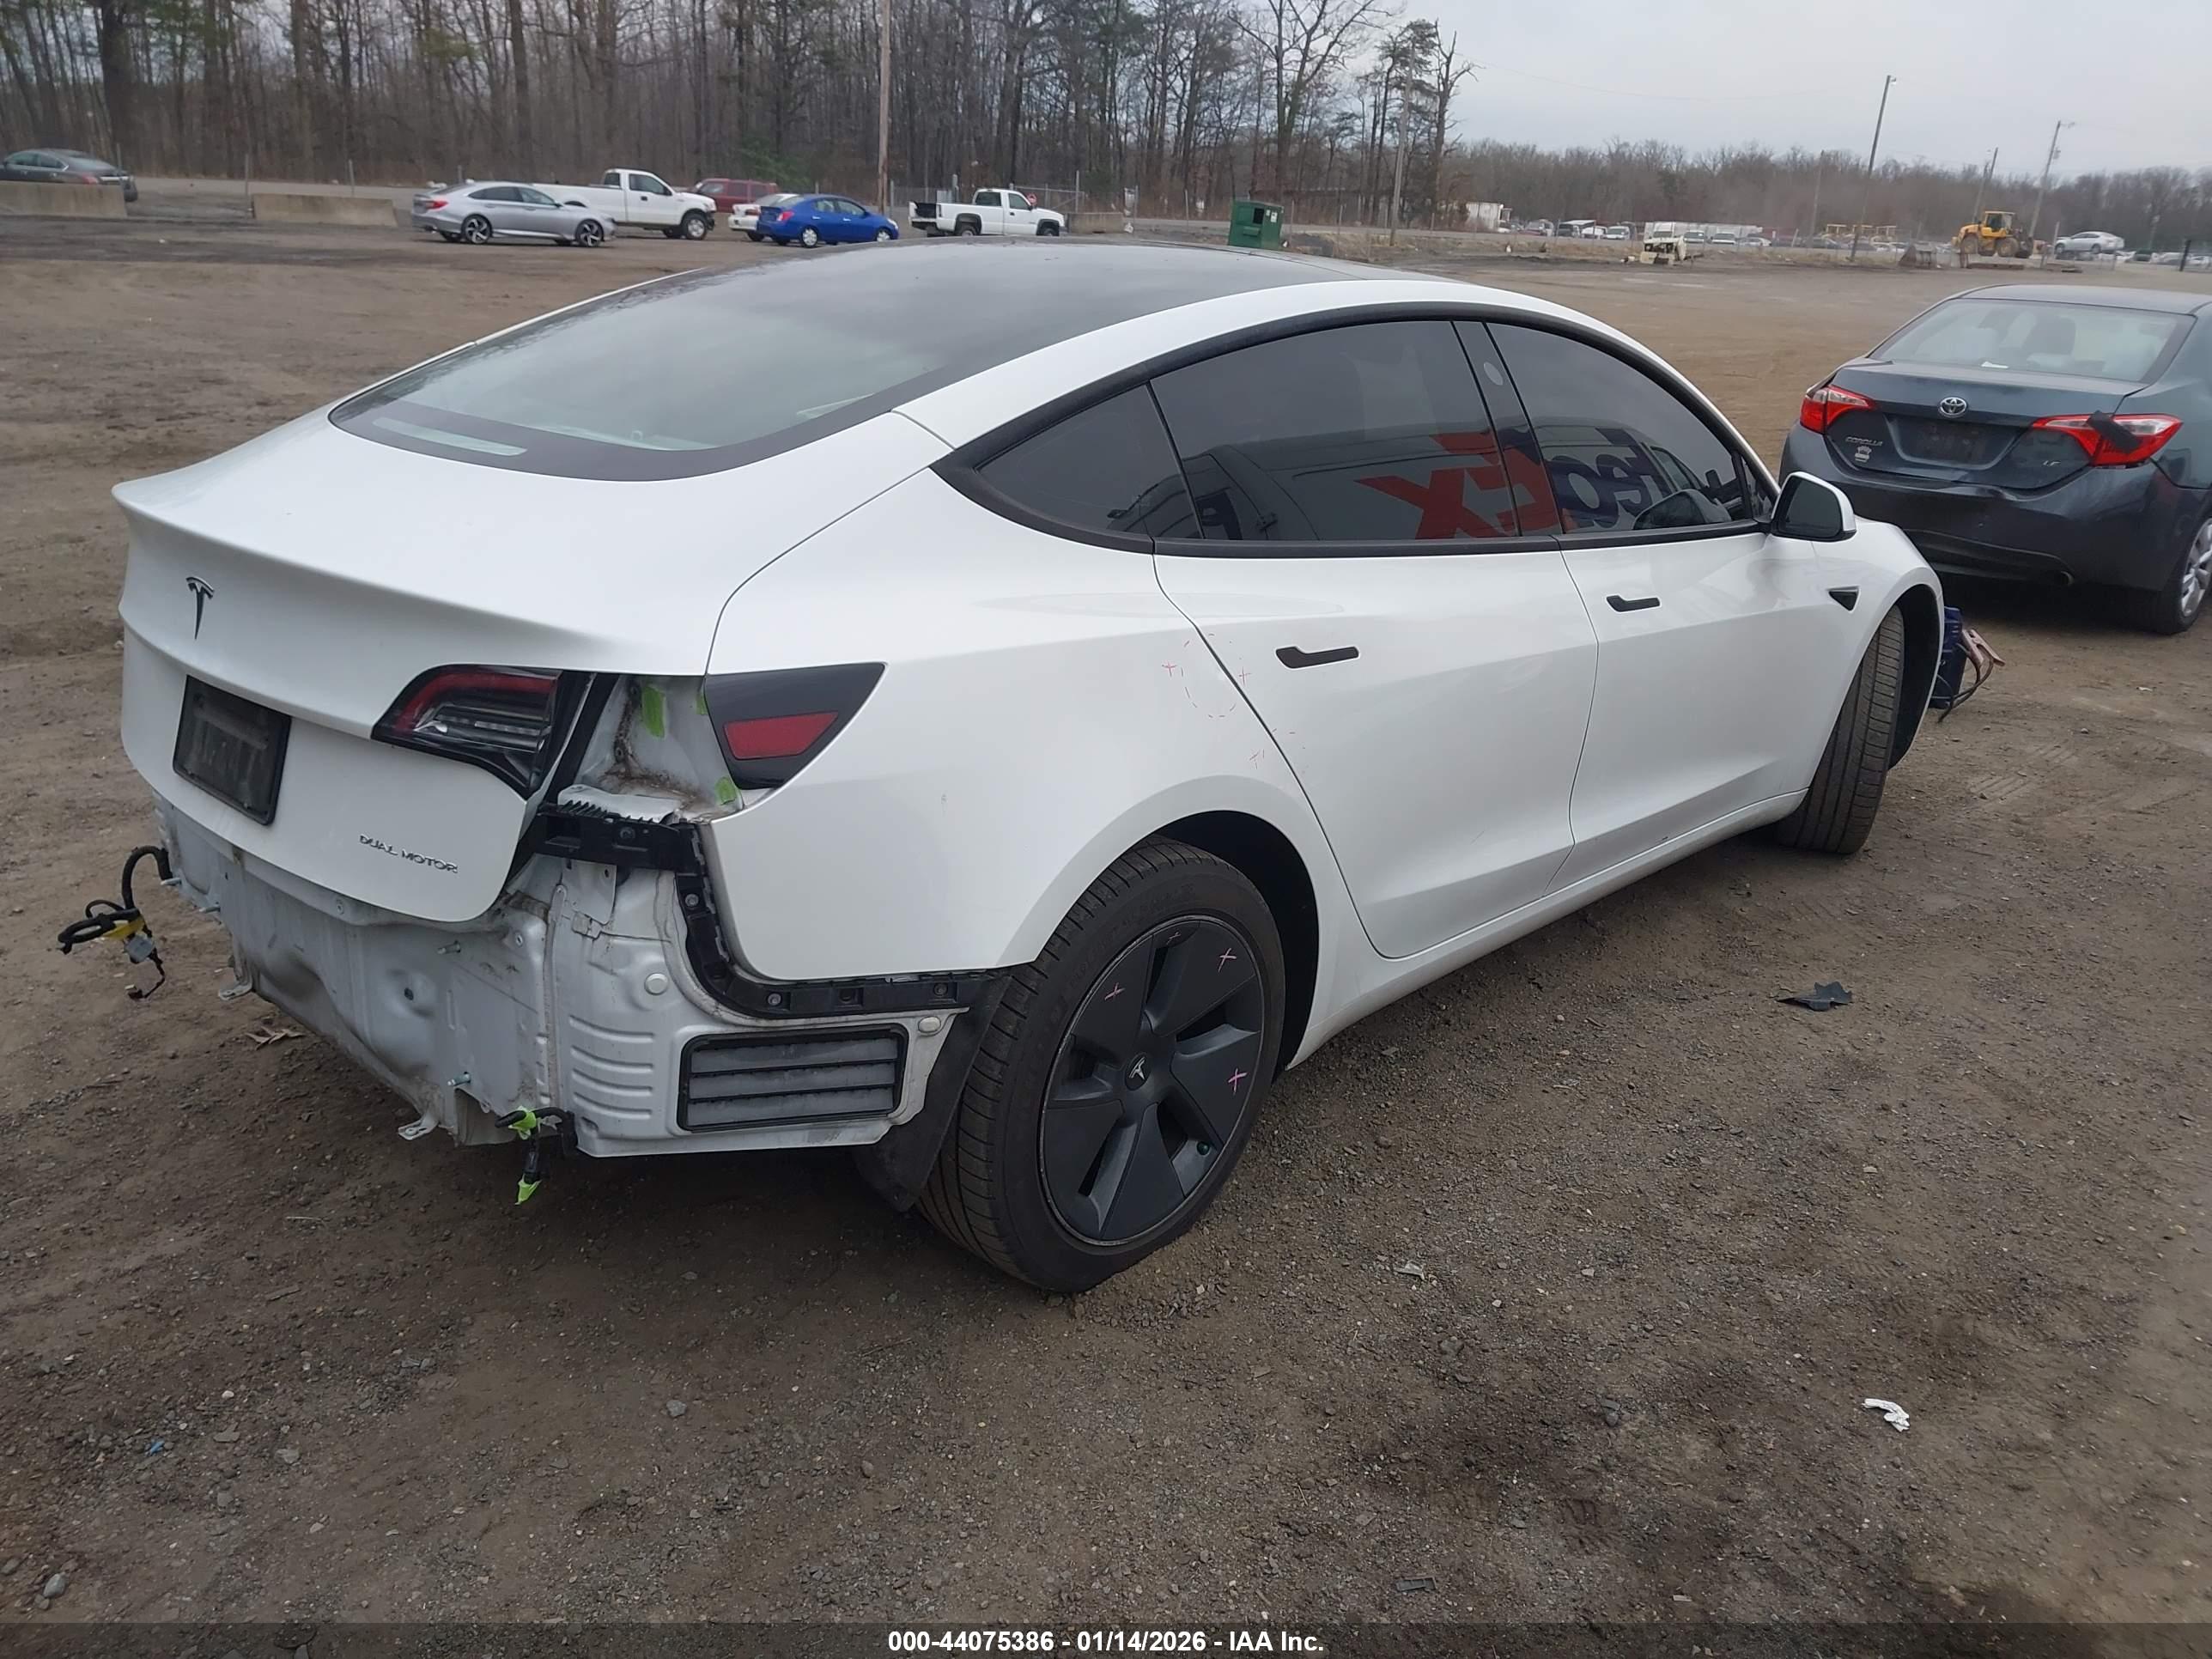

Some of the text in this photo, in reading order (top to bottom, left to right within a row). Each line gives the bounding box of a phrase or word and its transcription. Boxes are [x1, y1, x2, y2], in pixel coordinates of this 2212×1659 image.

[1844, 435, 1883, 447] COROLLA
[359, 833, 459, 874] DUAL MOTOR
